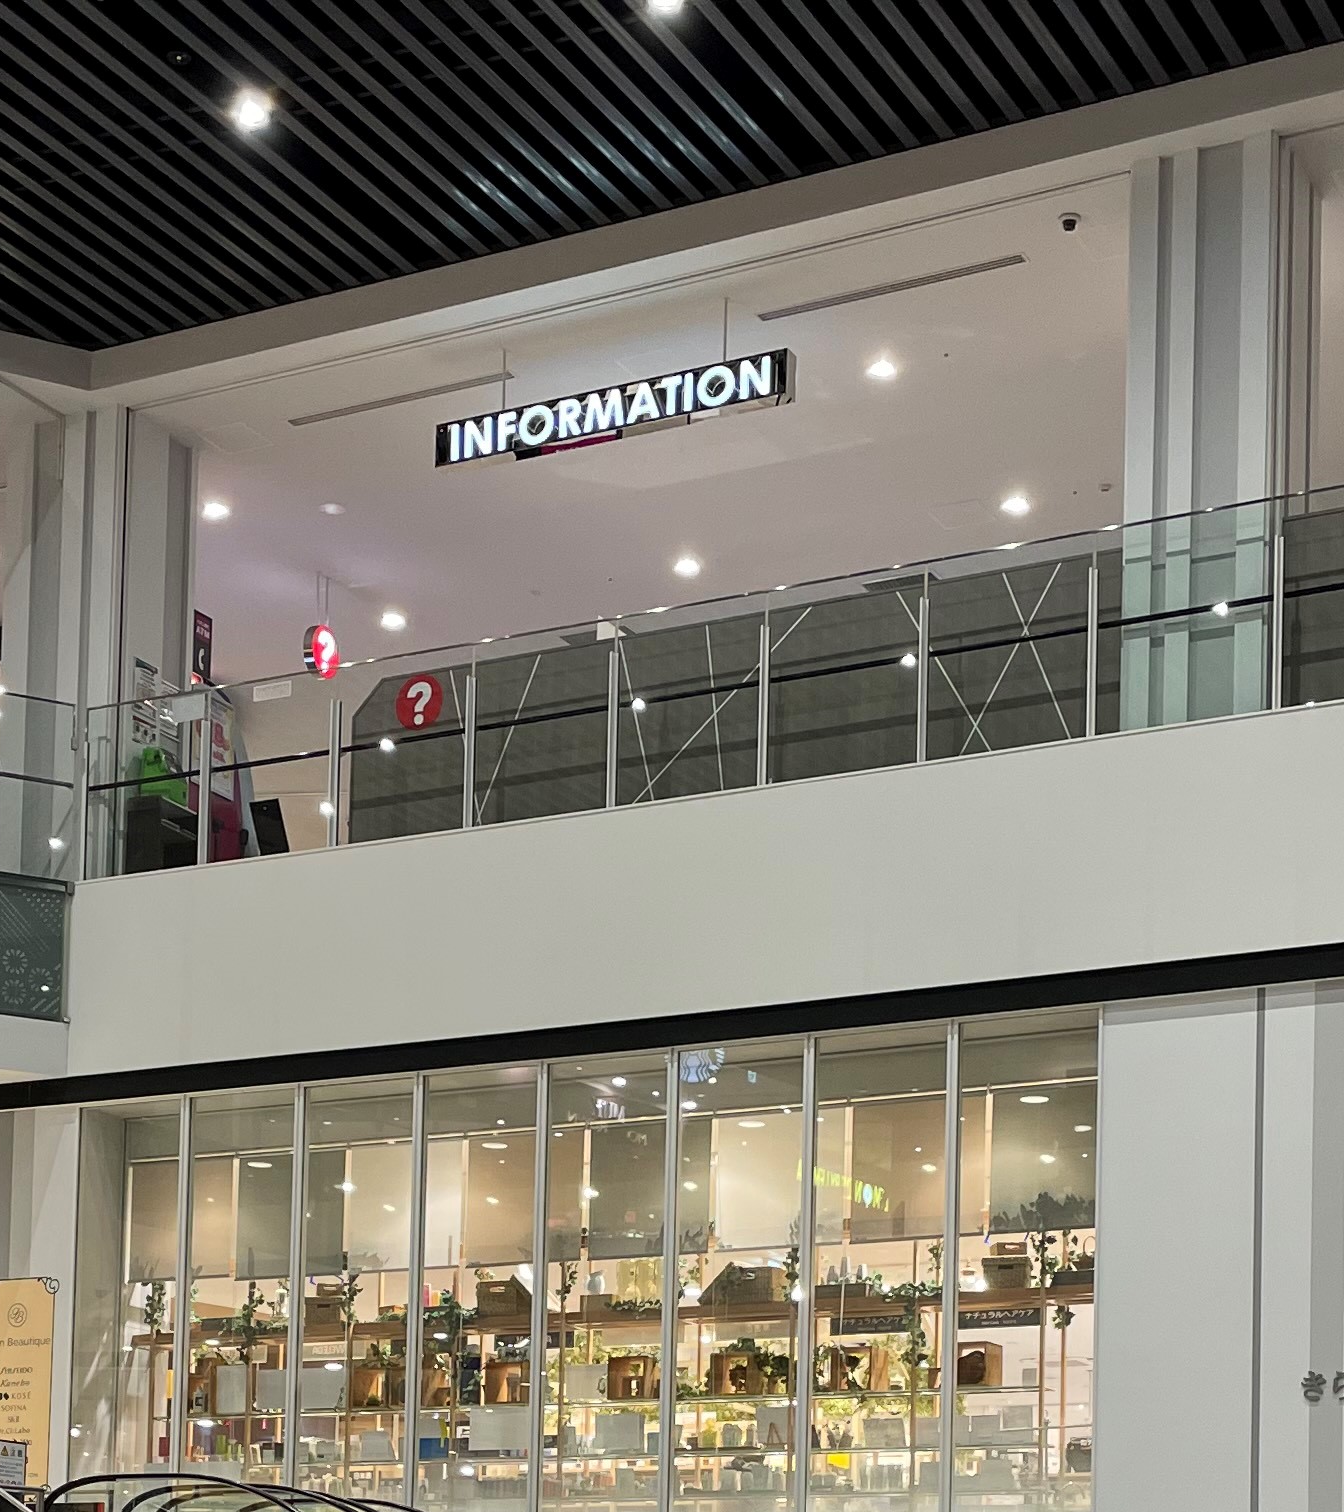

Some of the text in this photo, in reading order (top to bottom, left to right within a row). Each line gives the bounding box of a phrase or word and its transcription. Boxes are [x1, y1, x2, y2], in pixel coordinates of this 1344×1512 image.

[450, 355, 773, 462] INFORMATION
[7, 1337, 51, 1348] Beautique
[0, 1379, 30, 1388] Kanebo
